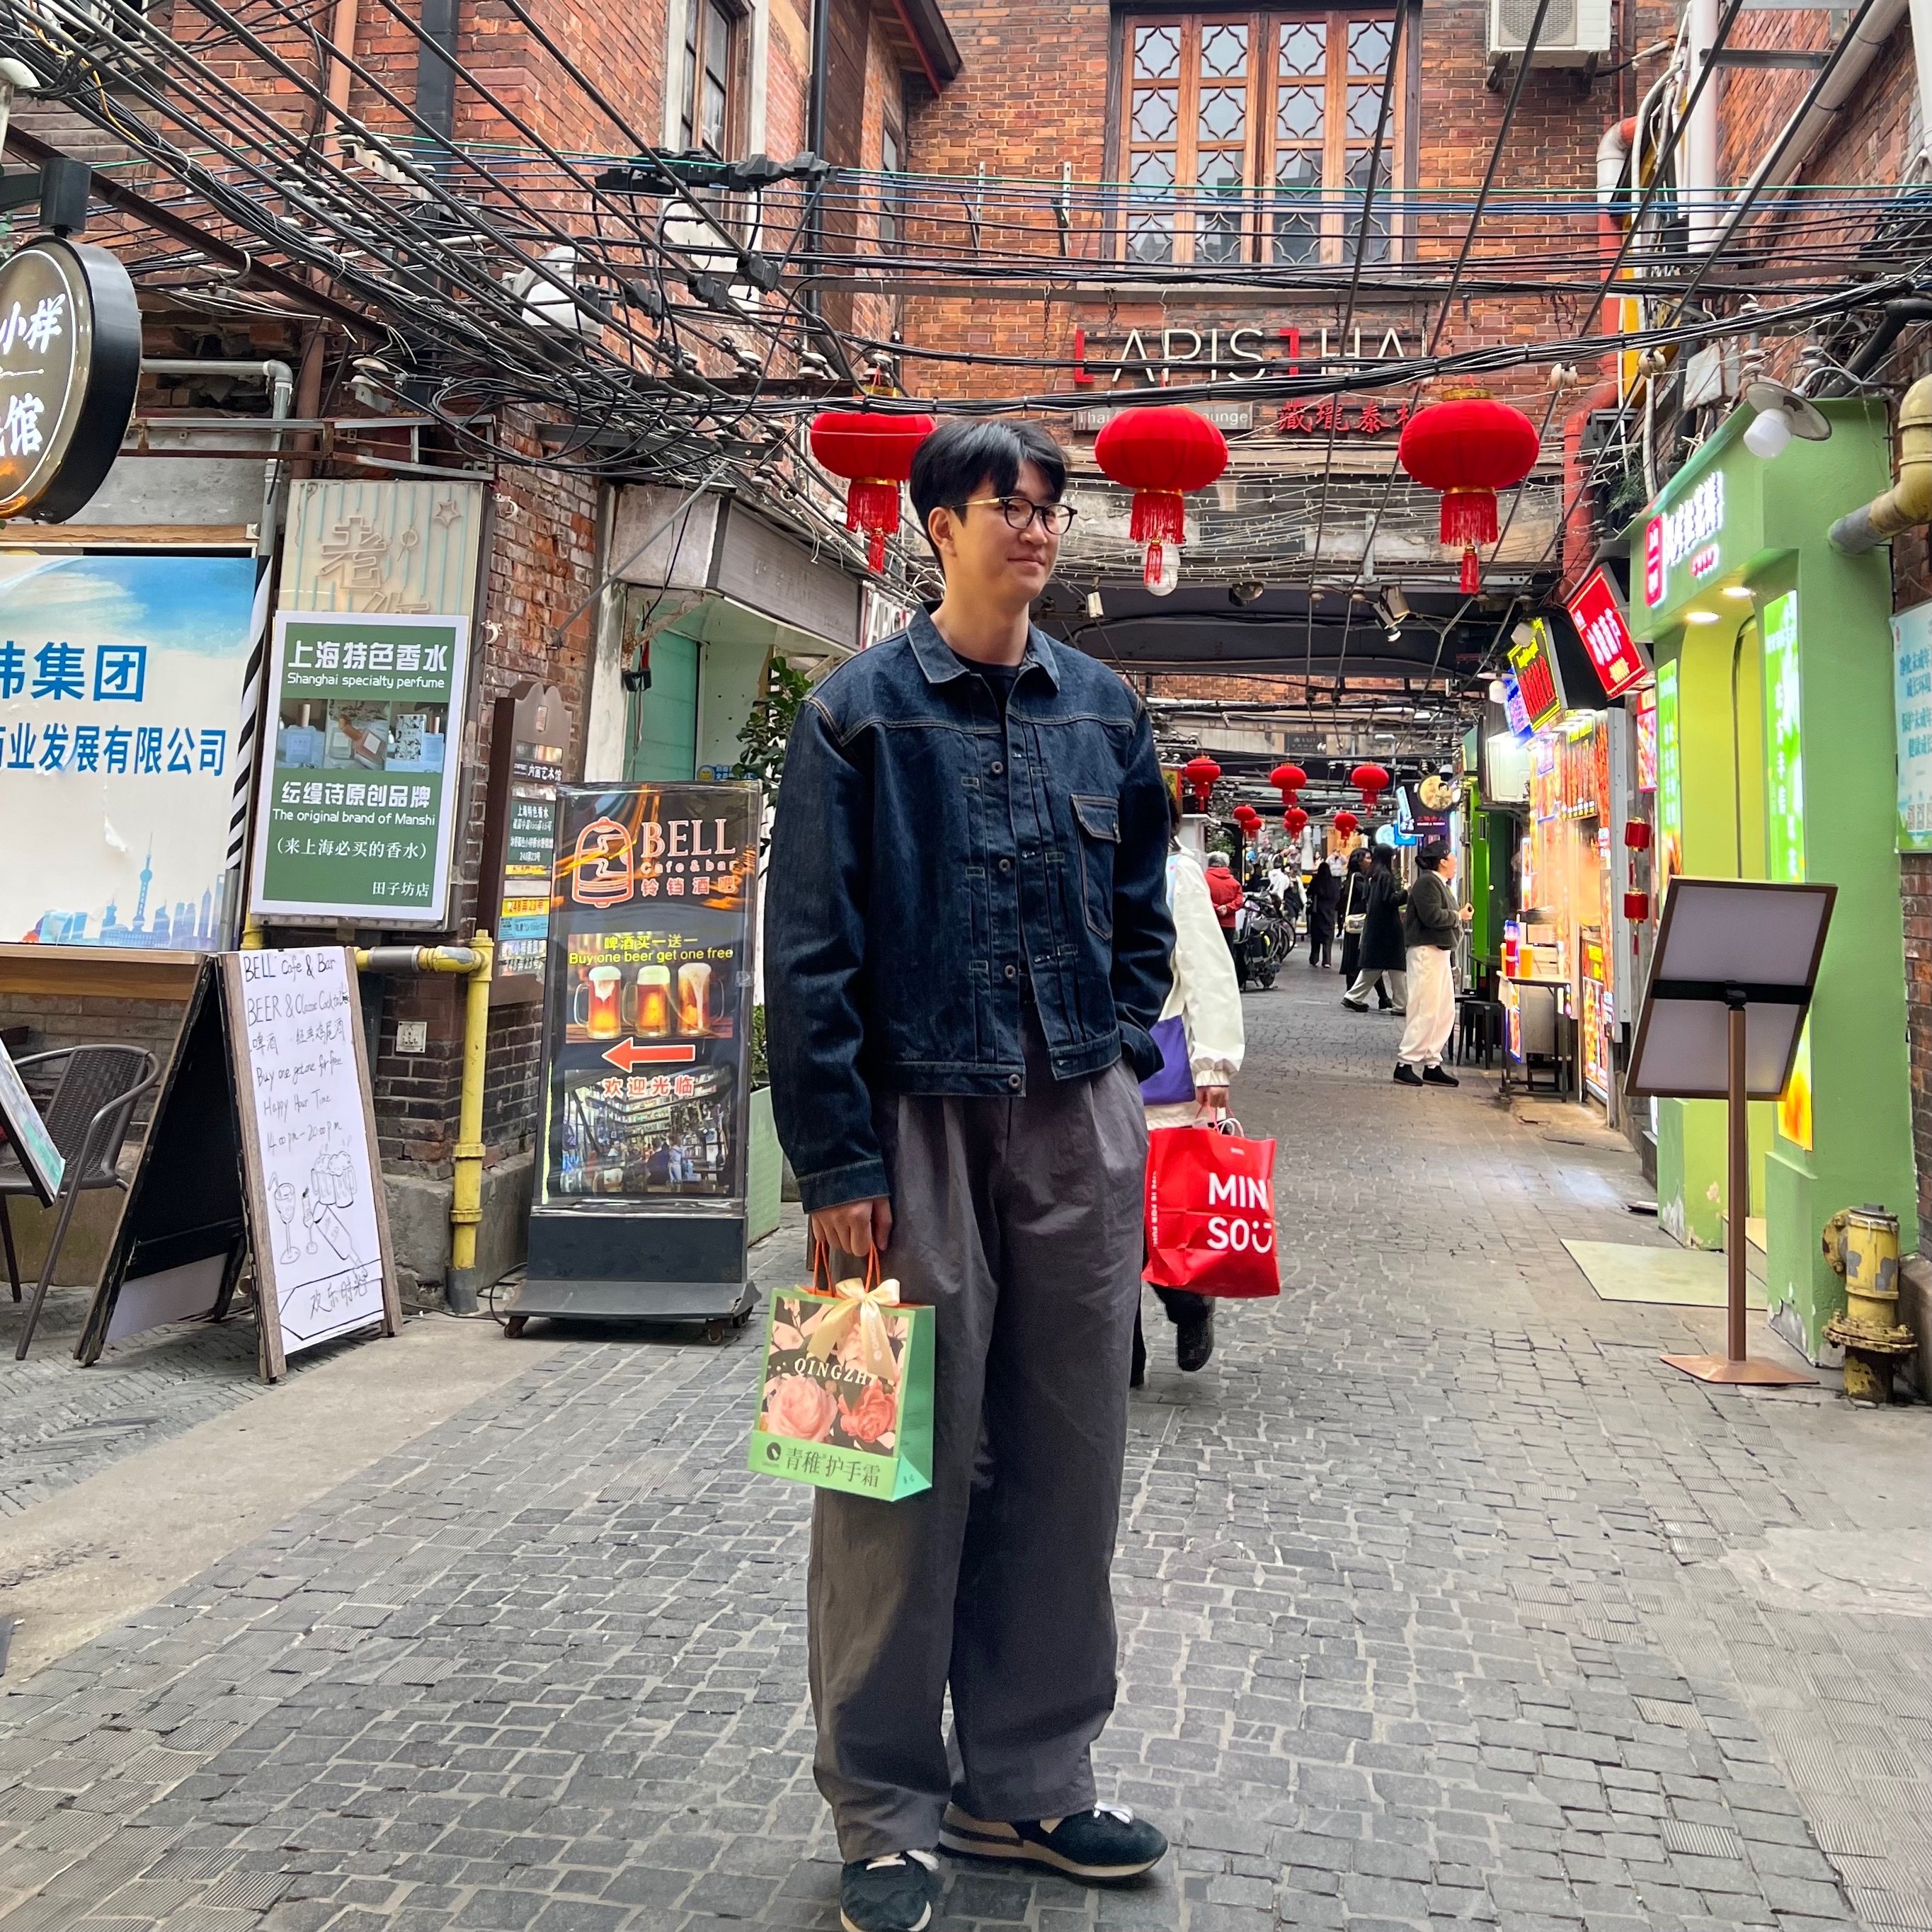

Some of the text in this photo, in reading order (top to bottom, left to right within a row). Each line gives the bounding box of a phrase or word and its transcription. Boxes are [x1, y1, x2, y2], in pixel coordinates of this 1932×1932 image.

[1078, 411, 1110, 423] Thai
[287, 640, 448, 671] 上海特色香水
[287, 672, 445, 689] Shanghai specialty perfume
[0, 723, 226, 777] 业发展有限公司
[273, 808, 435, 825] The original brand of Manshi
[278, 837, 427, 859] （来上海必买的香水）
[641, 818, 736, 858] BELL
[372, 881, 429, 897] 田子坊店
[641, 876, 735, 897] 铃铛酒吧
[604, 934, 698, 951] 啤酒买一送一
[569, 947, 733, 965] Buy one beer get one free
[244, 953, 336, 982] BELL Cafe & Bar
[248, 995, 282, 1027] BEER
[285, 993, 295, 1018] &
[256, 1068, 275, 1092] Buy
[602, 1075, 695, 1097] 欢迎光临
[263, 1097, 288, 1123] Happy
